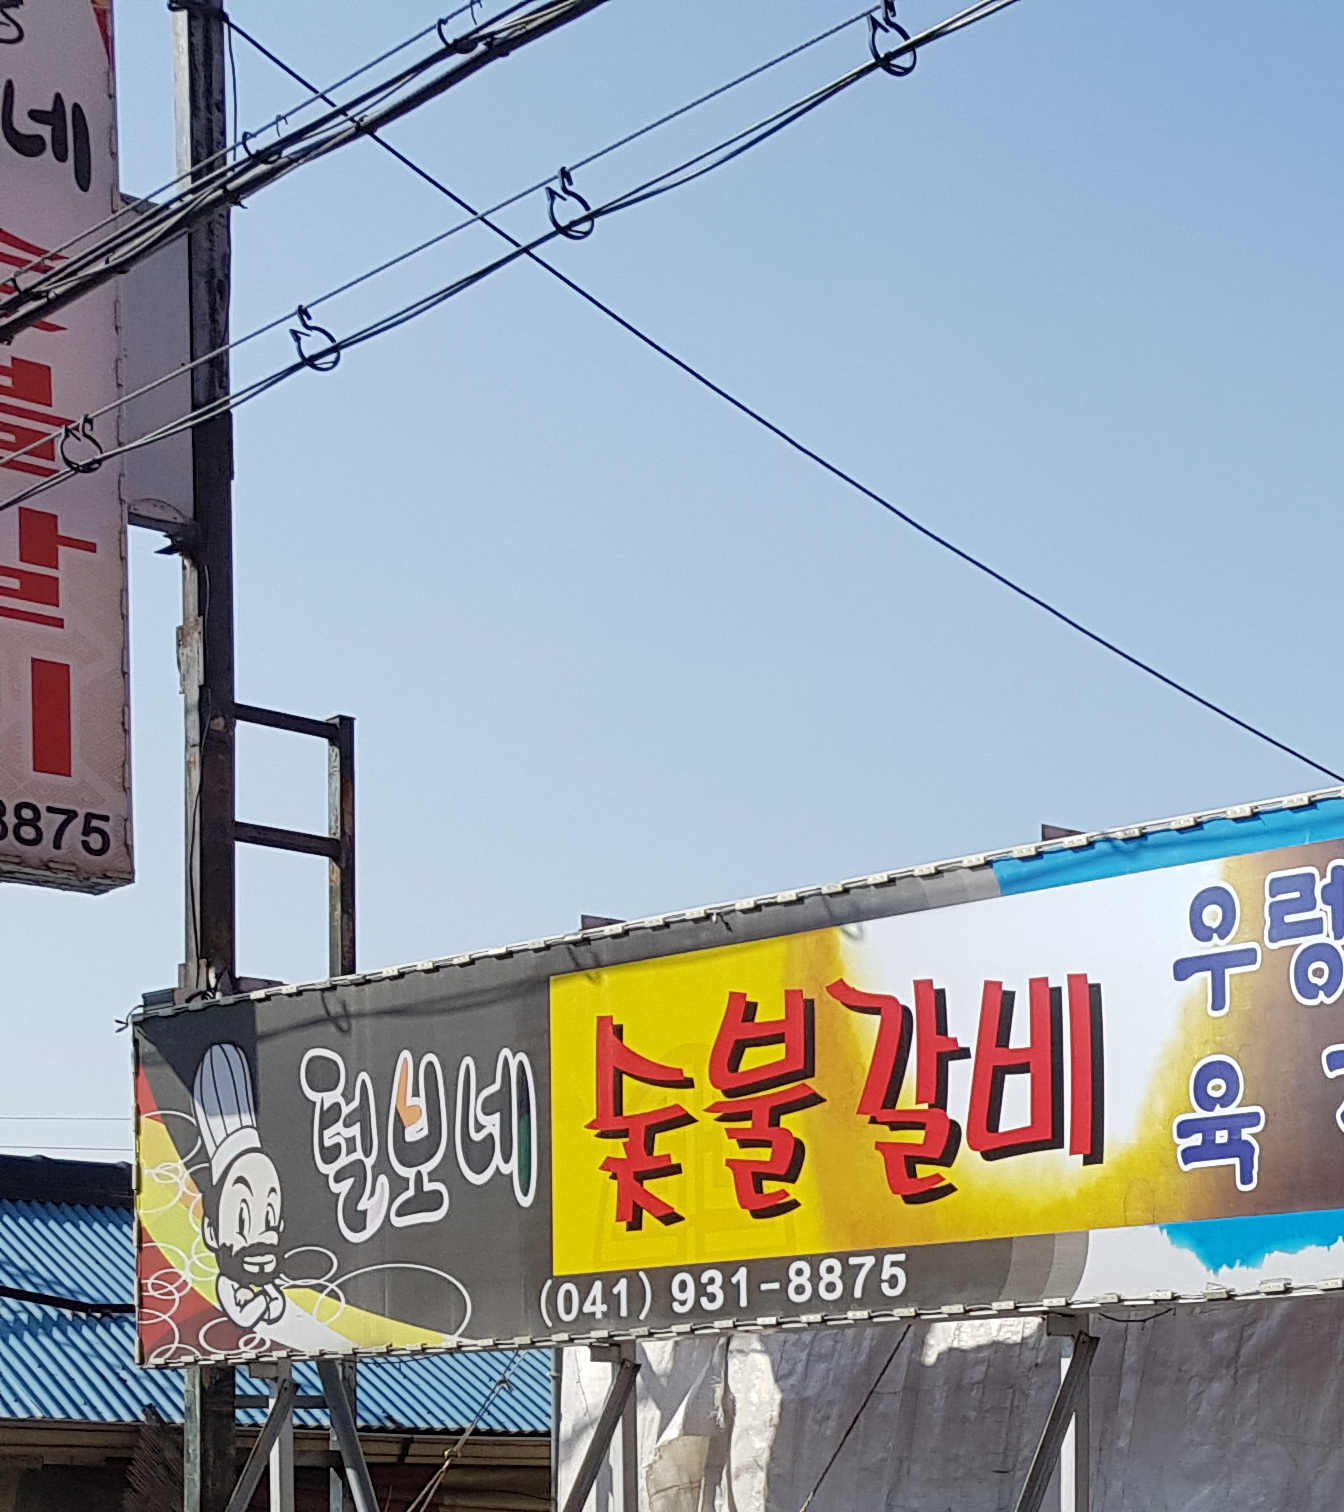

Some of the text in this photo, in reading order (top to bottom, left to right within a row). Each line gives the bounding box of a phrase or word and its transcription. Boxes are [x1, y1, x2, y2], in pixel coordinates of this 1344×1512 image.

[0, 799, 111, 856] 875
[299, 1043, 538, 1244] 털보네
[583, 971, 1104, 1232] 숯불갈비
[539, 1252, 908, 1329] (041) 931-8875
